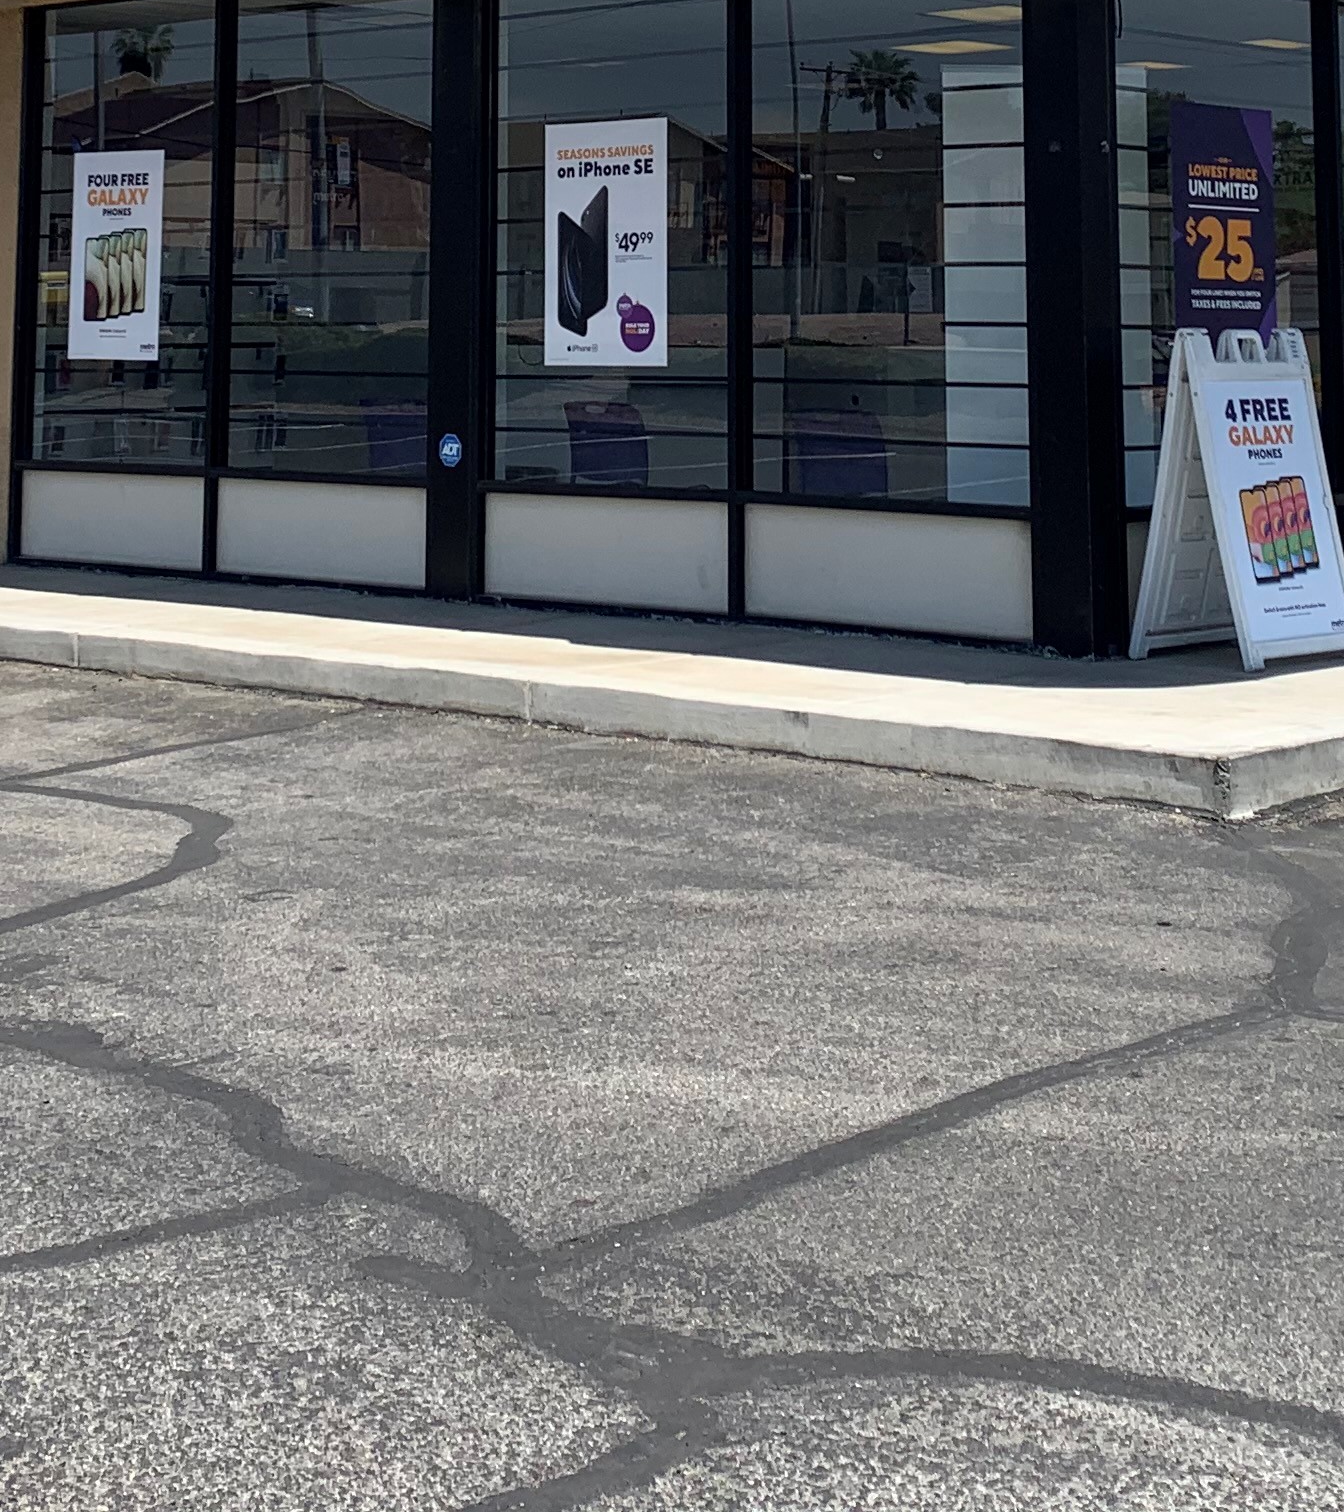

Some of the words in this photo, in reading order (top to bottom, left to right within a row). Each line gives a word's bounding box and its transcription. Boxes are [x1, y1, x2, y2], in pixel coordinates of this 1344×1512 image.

[556, 147, 606, 161] SEASONS
[607, 144, 654, 158] SAVINGS
[557, 167, 575, 178] on
[578, 160, 631, 178] iPhone
[633, 158, 654, 175] SE
[1188, 163, 1227, 179] LOWEST
[1229, 167, 1258, 182] PRICE
[87, 173, 118, 188] FOUR
[120, 172, 150, 187] FREE
[87, 188, 149, 207] GALAXY
[1188, 179, 1258, 201] UNLIMITED
[102, 207, 132, 217] PHONES
[1185, 215, 1254, 283] $25
[1191, 298, 1210, 309] TAXES
[1216, 299, 1231, 309] FEES
[1231, 300, 1262, 310] INCLUDED
[1225, 399, 1237, 423] 4
[1239, 398, 1292, 423] FREE
[1228, 425, 1294, 446] GALAXY
[1247, 448, 1283, 459] PHONES
